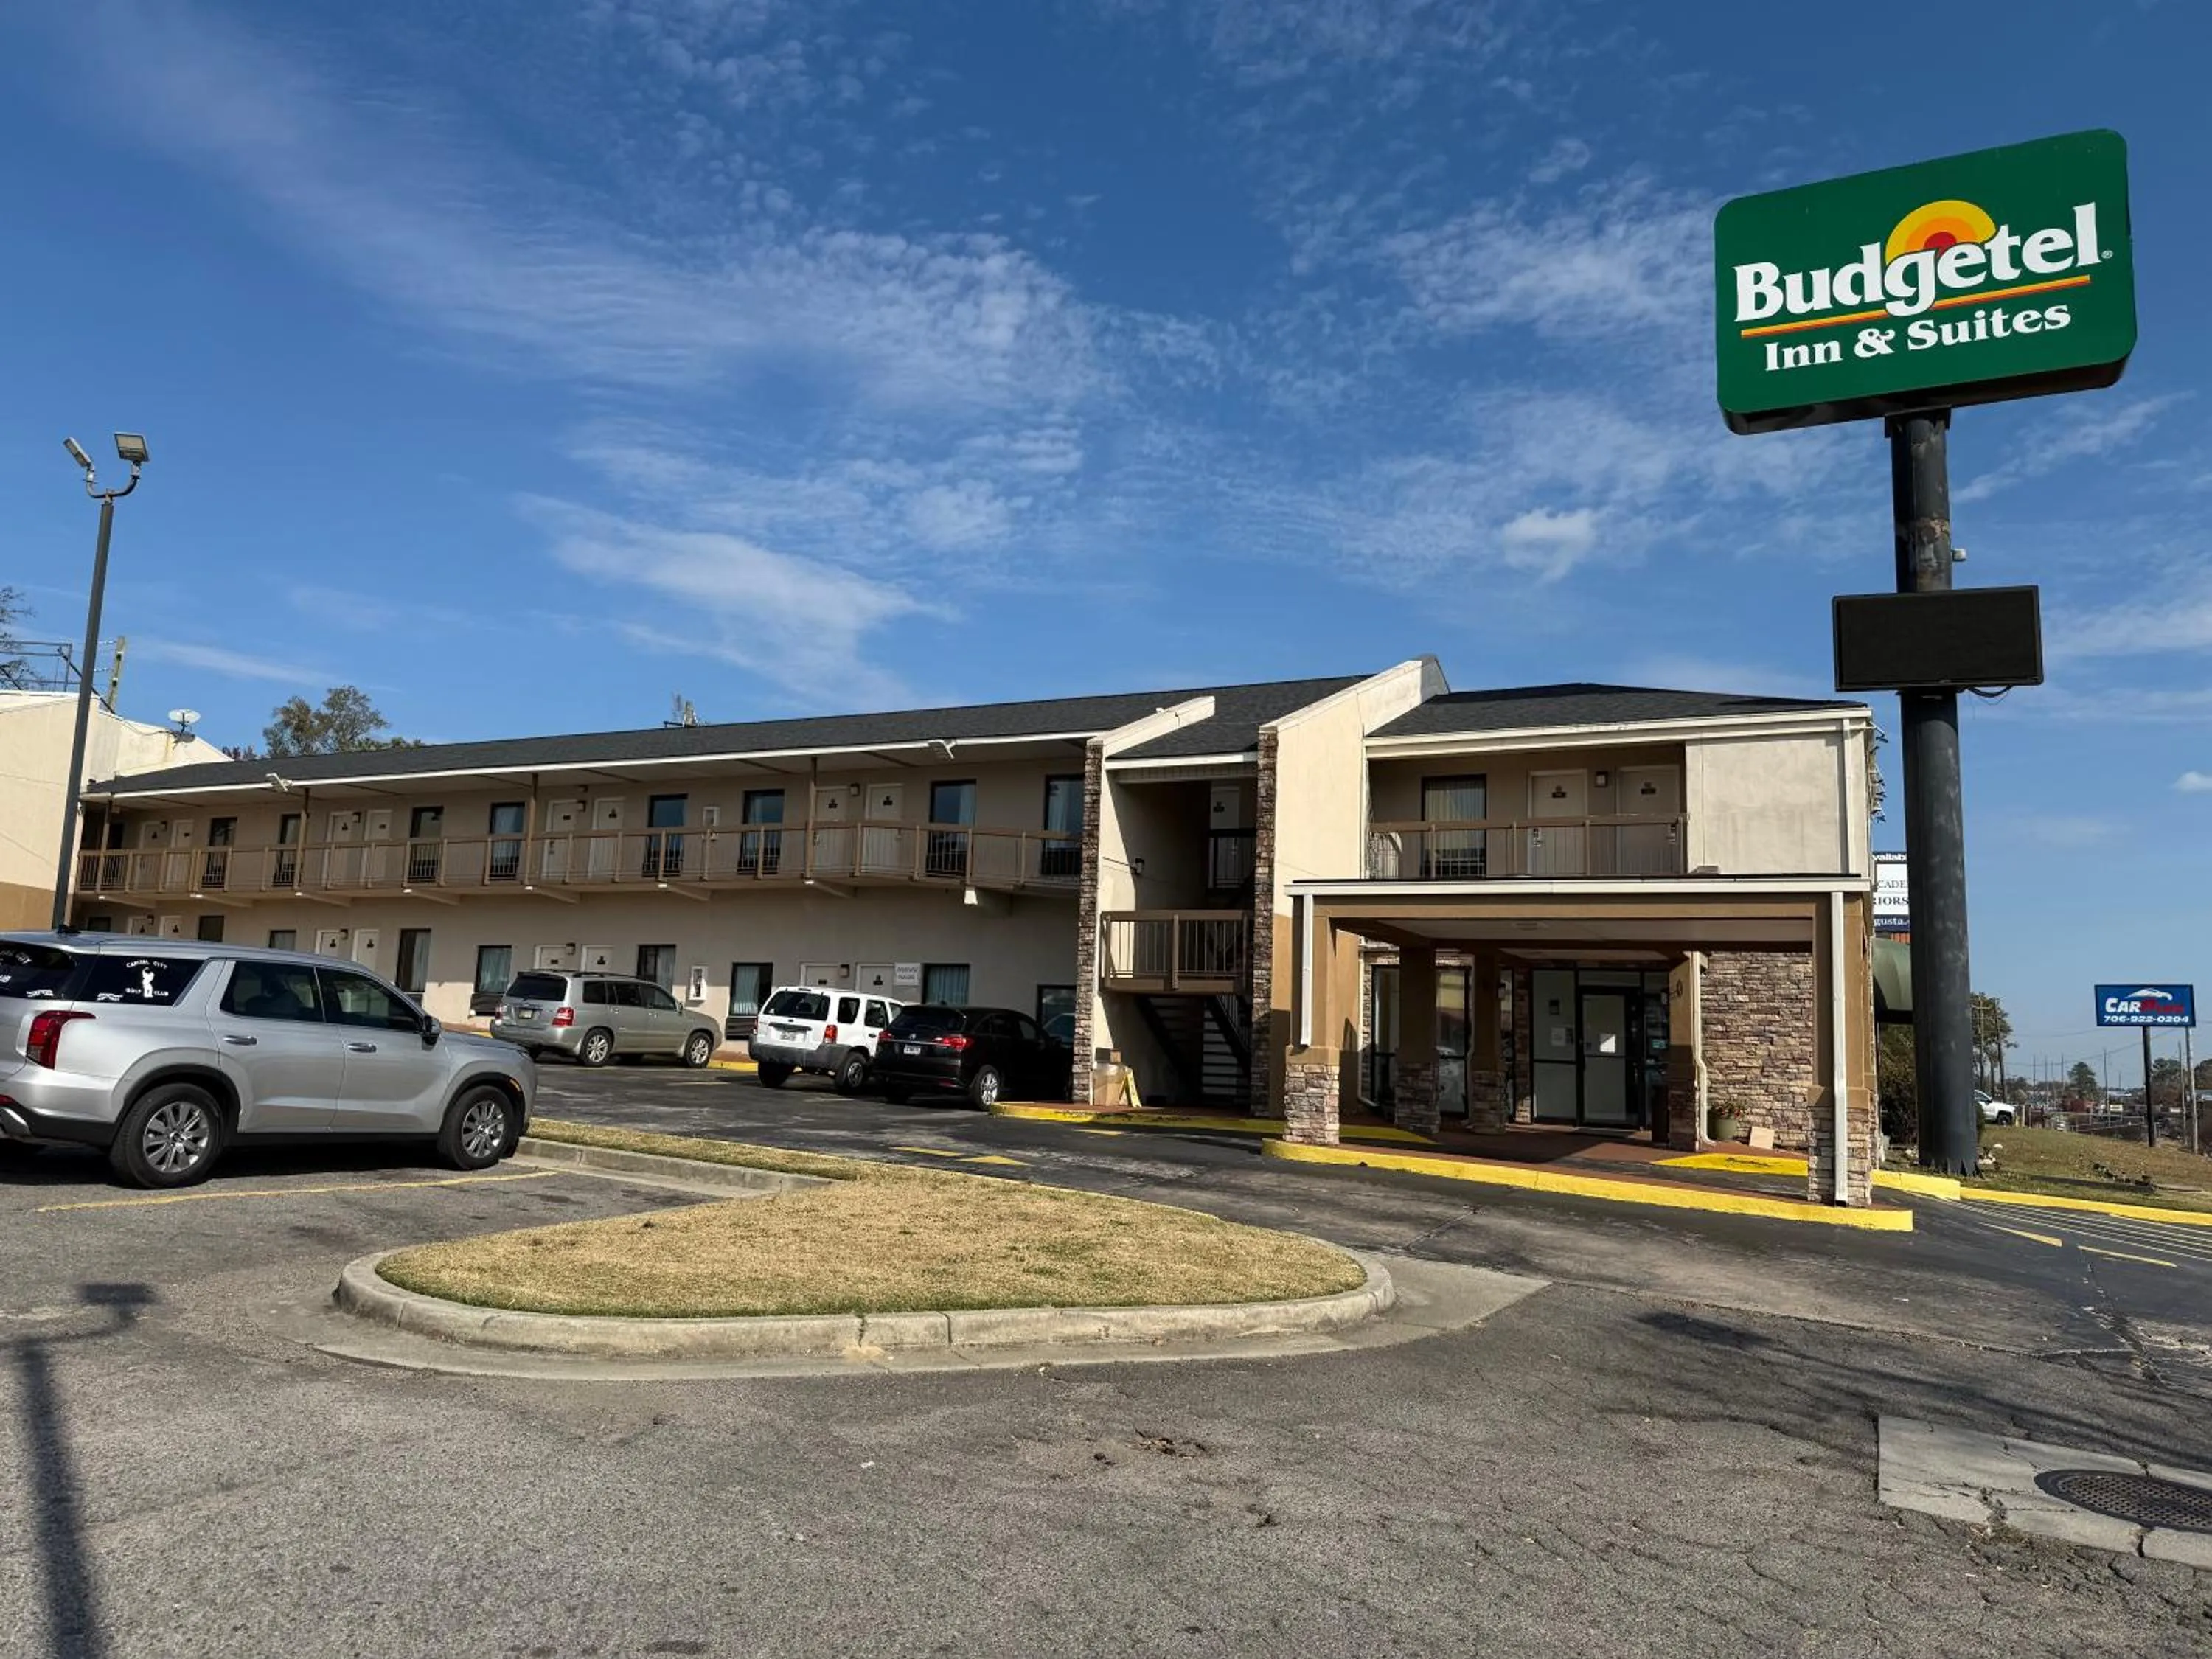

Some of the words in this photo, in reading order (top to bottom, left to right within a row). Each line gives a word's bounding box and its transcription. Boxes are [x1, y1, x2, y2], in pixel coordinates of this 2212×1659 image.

[1733, 201, 2101, 316] Budgetel
[1765, 340, 1843, 371] Inn
[1854, 328, 1896, 358] &
[1907, 305, 2071, 351] Suites
